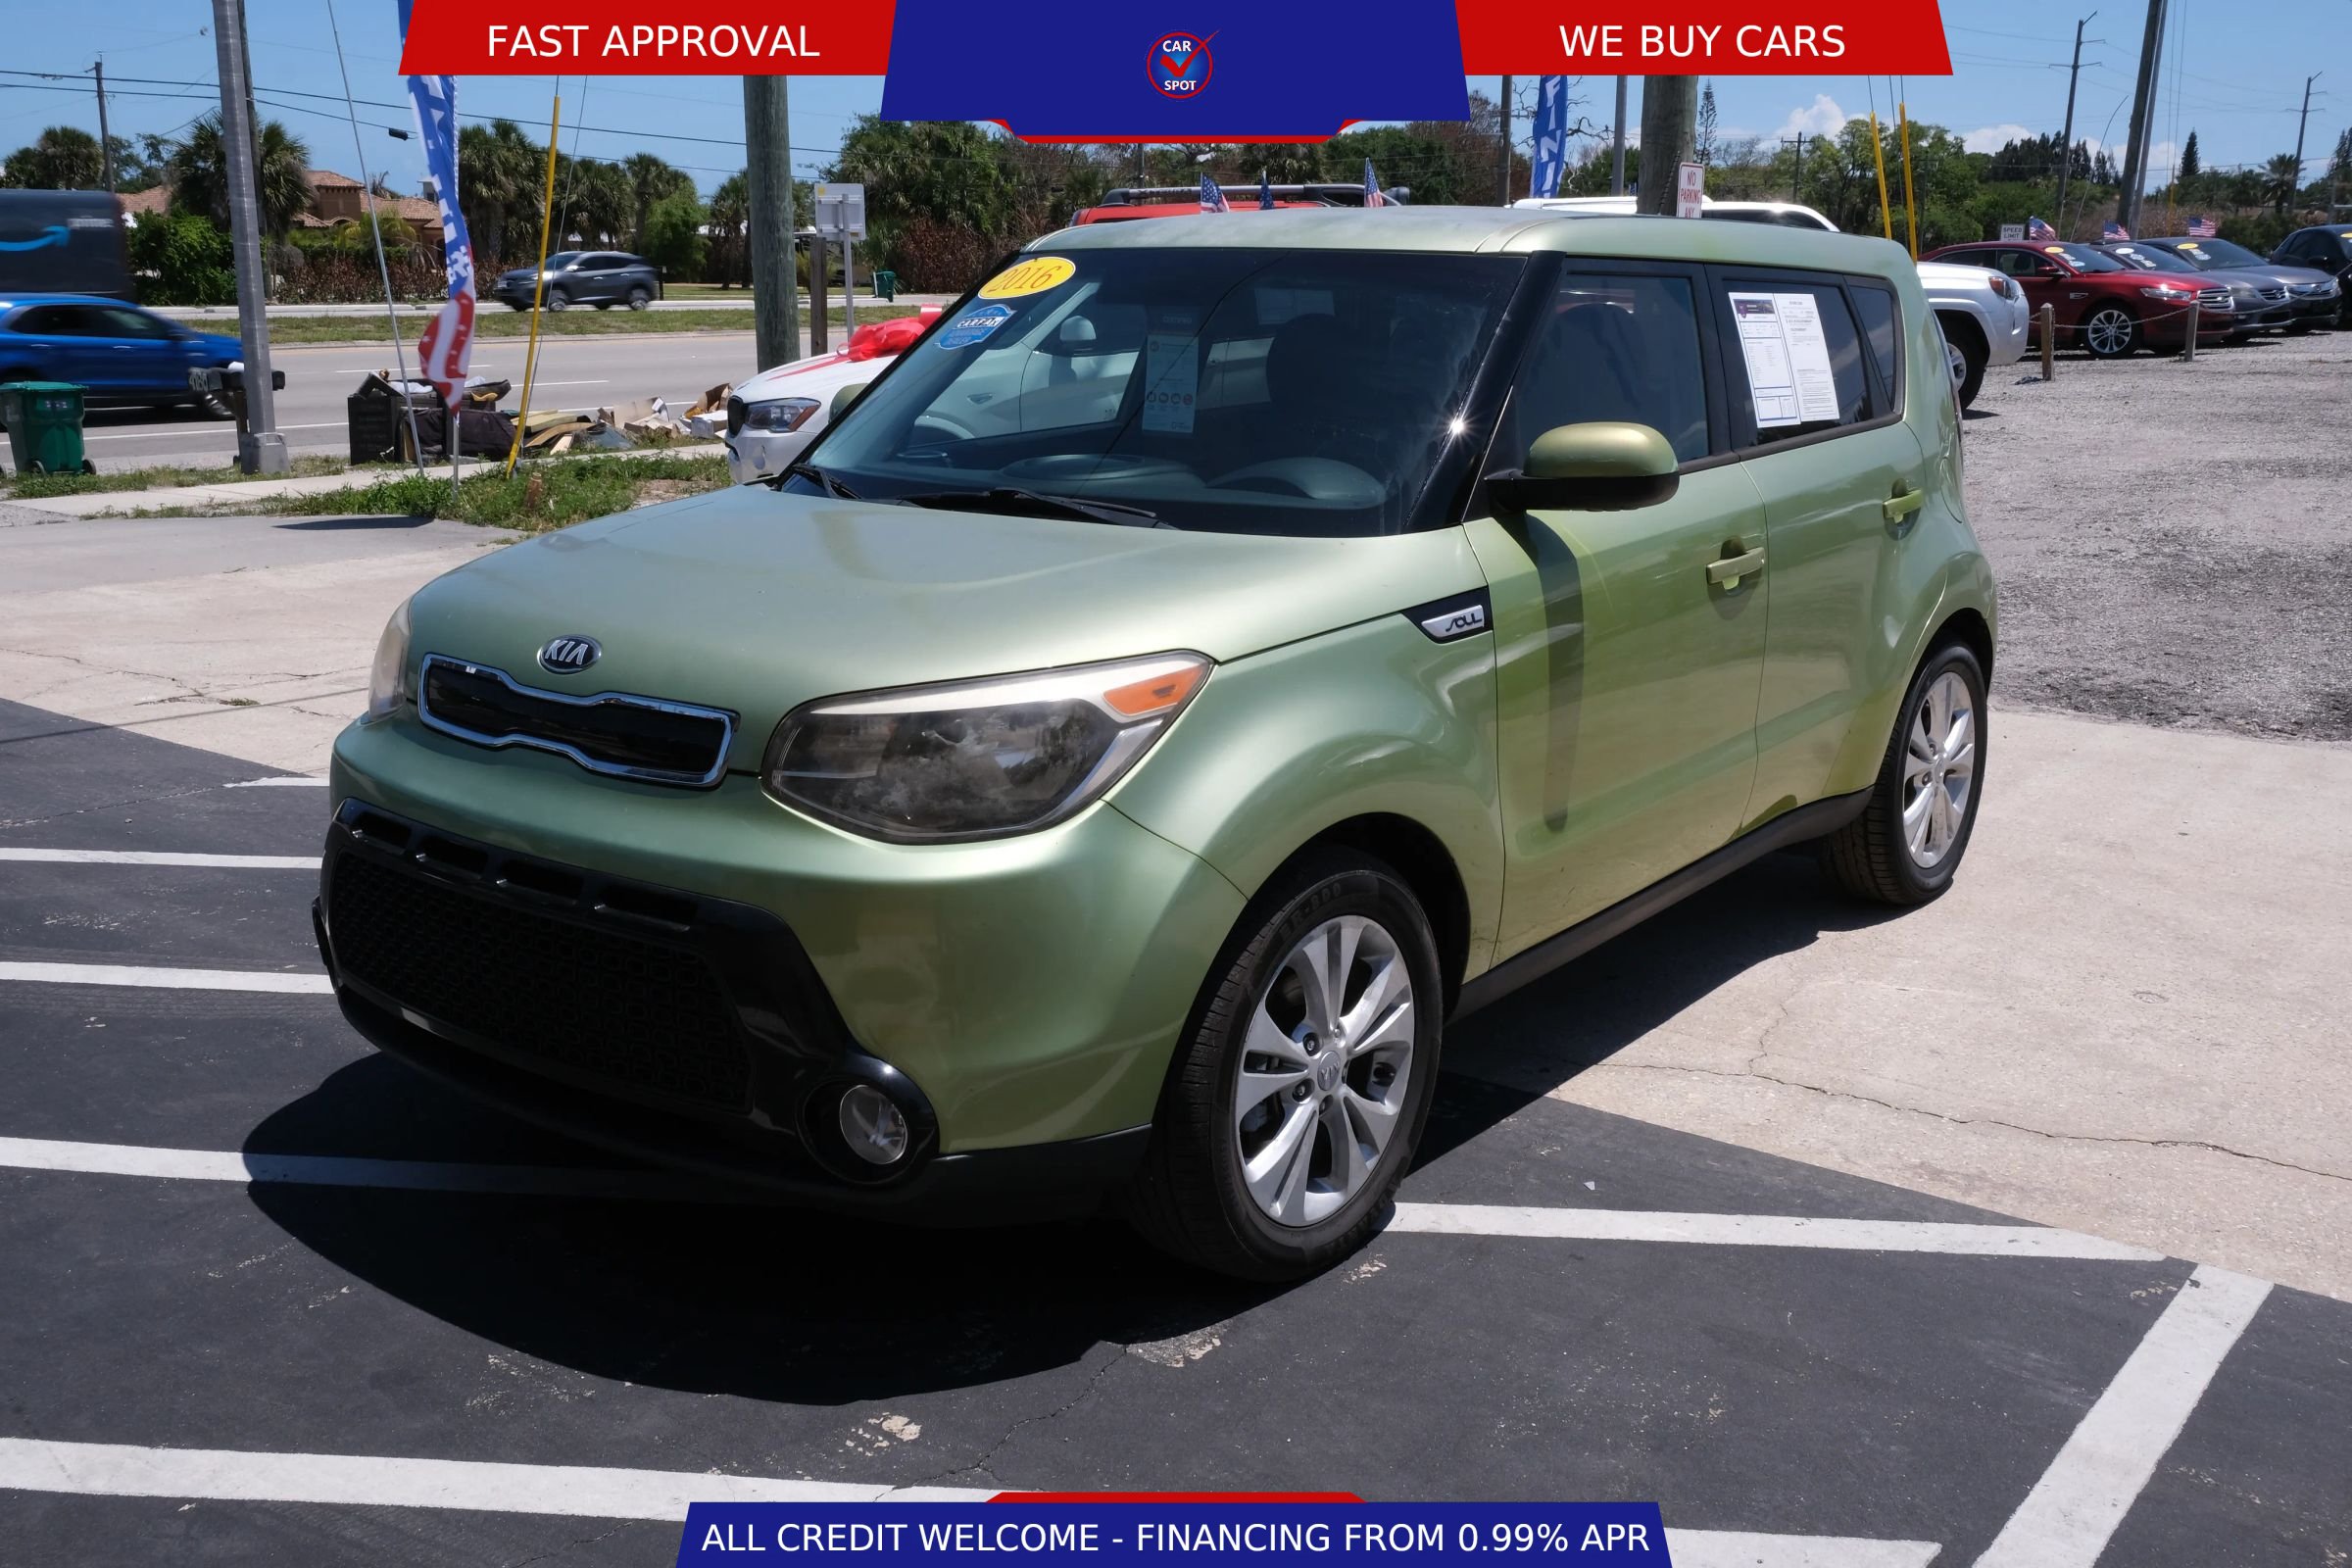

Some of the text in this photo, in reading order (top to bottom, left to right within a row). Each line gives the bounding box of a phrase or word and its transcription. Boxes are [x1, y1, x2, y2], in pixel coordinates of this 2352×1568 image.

[1688, 171, 1696, 186] NO
[986, 265, 1062, 293] 2016
[544, 639, 588, 665] KIA
